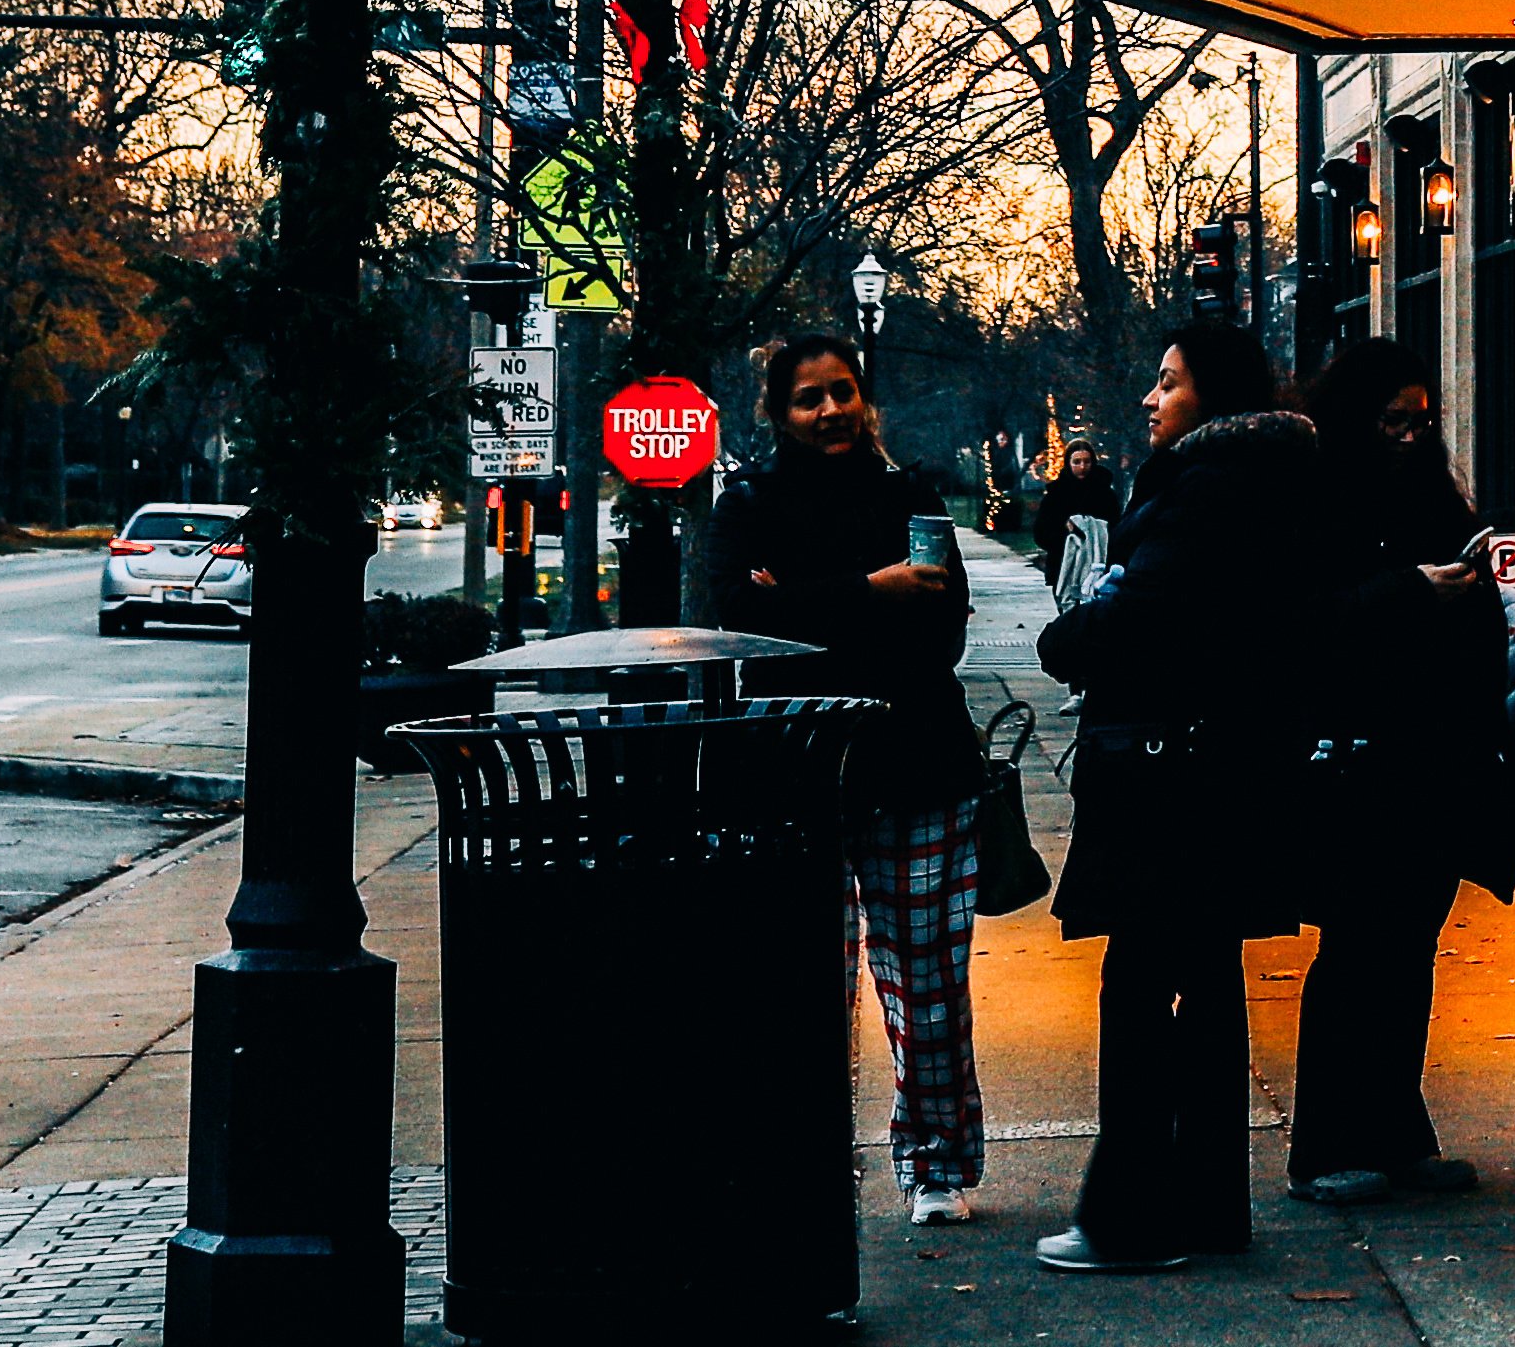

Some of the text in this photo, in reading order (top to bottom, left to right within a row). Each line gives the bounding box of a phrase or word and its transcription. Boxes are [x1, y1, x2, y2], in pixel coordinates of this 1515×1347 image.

[501, 359, 526, 375] NO
[492, 382, 539, 399] URN
[512, 406, 549, 422] RED
[609, 409, 711, 432] TROLLEY
[527, 440, 548, 448] DAYS
[630, 434, 690, 458] STOP
